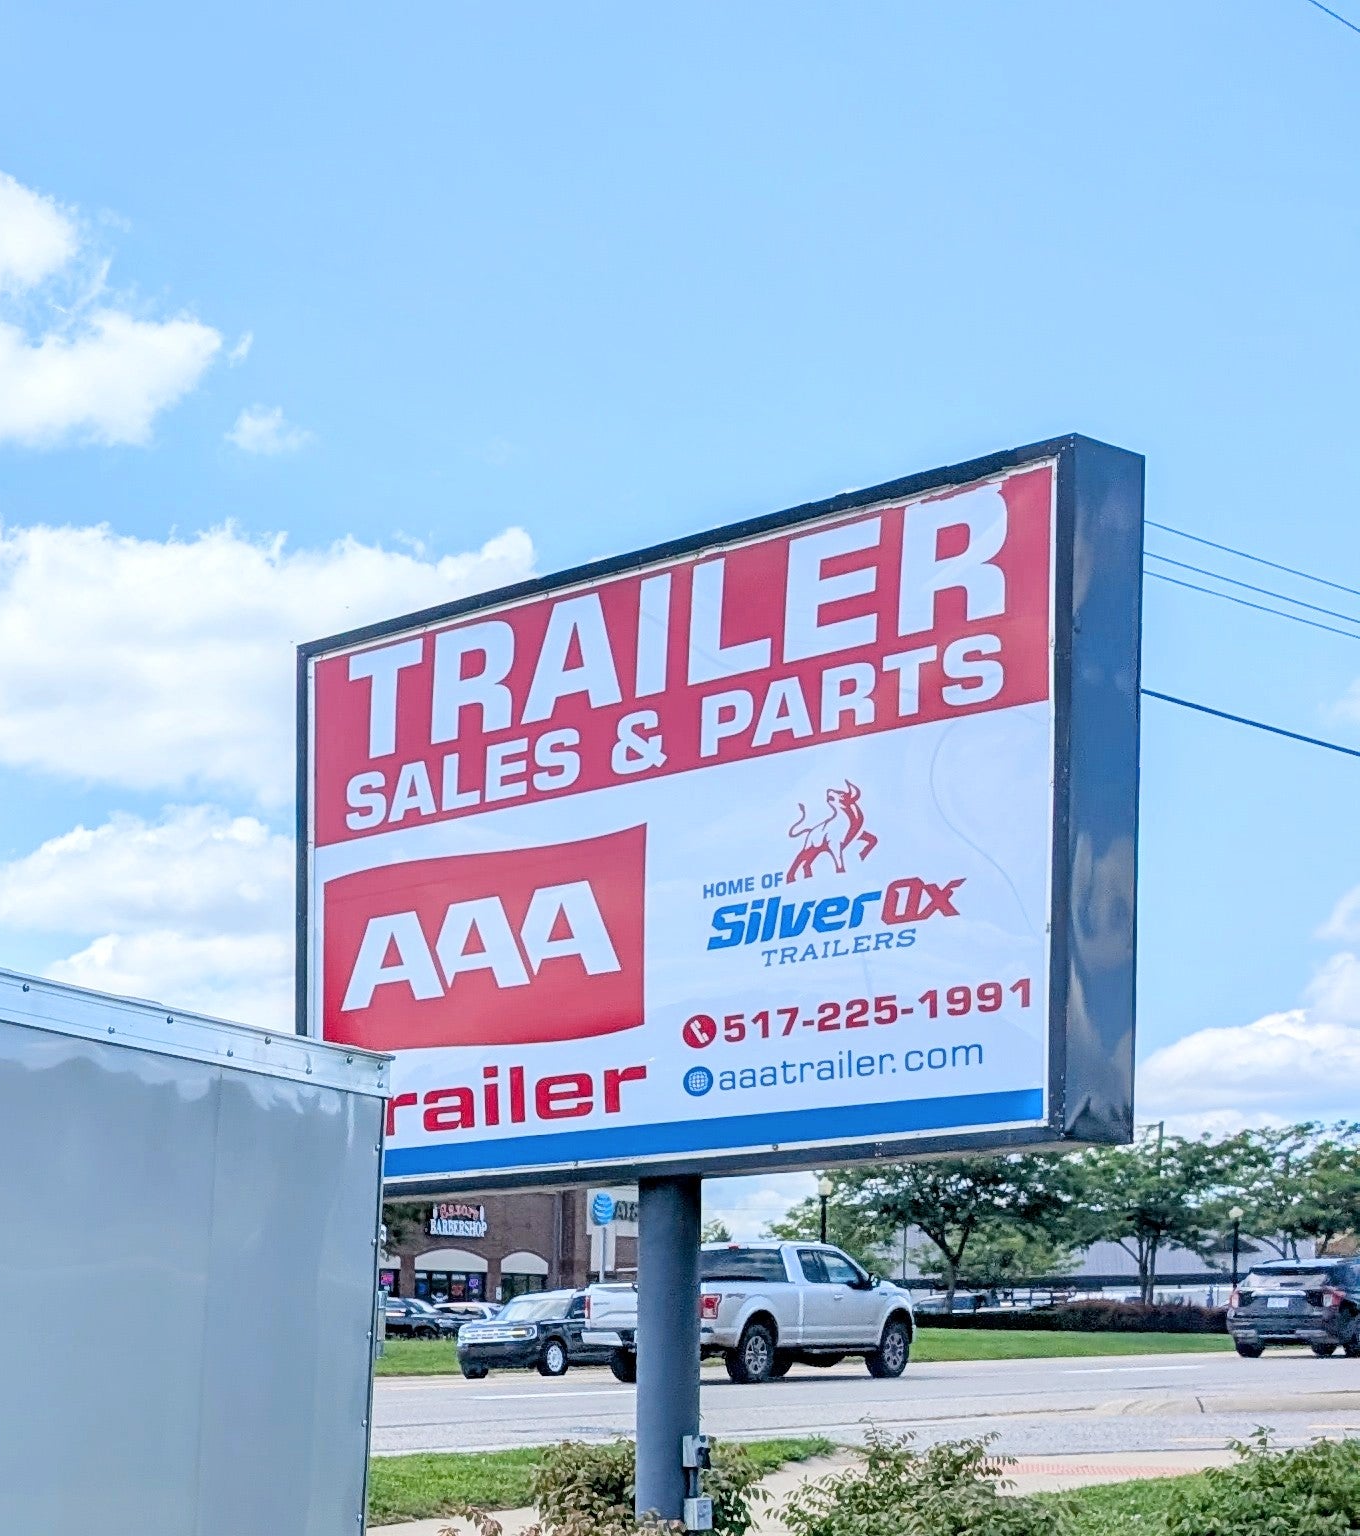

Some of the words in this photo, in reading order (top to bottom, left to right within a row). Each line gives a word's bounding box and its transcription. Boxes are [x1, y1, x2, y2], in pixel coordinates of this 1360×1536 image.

[348, 482, 1009, 759] TRAILER
[345, 728, 581, 831] SALES
[611, 709, 668, 775] &
[700, 633, 1005, 758] PARTS
[702, 876, 755, 899] HOME
[761, 871, 784, 890] OF
[340, 880, 622, 1013] AAA
[761, 928, 918, 968] TRAILERS
[723, 977, 1032, 1043] 517-225-1991
[385, 1065, 647, 1136] railer
[718, 1042, 983, 1092] aaatrailer.com
